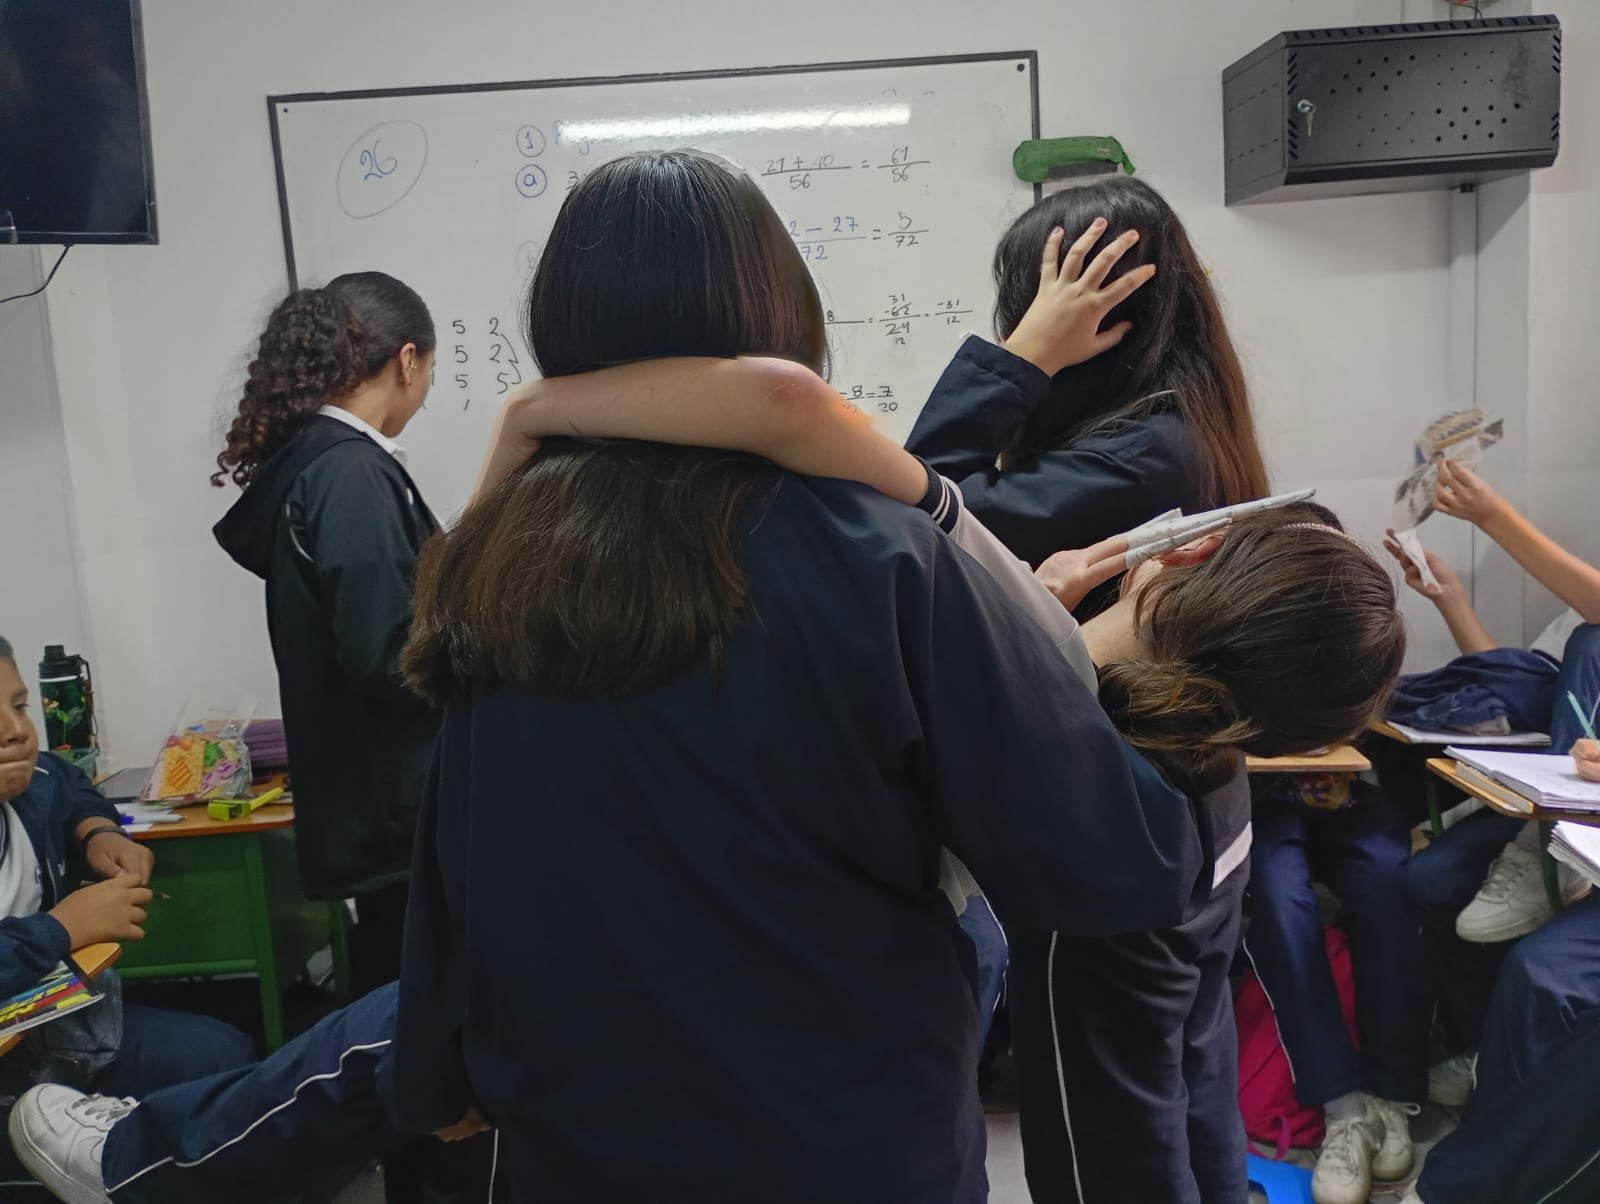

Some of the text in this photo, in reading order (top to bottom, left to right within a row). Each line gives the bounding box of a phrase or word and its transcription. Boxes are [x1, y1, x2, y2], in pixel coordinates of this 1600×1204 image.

[360, 139, 398, 180] 26
[790, 165, 909, 190] 56 56
[833, 216, 858, 233] 27
[801, 235, 919, 261] 72 72
[452, 317, 500, 337] 5 2
[885, 321, 911, 336] 24
[455, 344, 501, 364] 5 2
[455, 374, 469, 389] 5
[851, 385, 863, 398] 8
